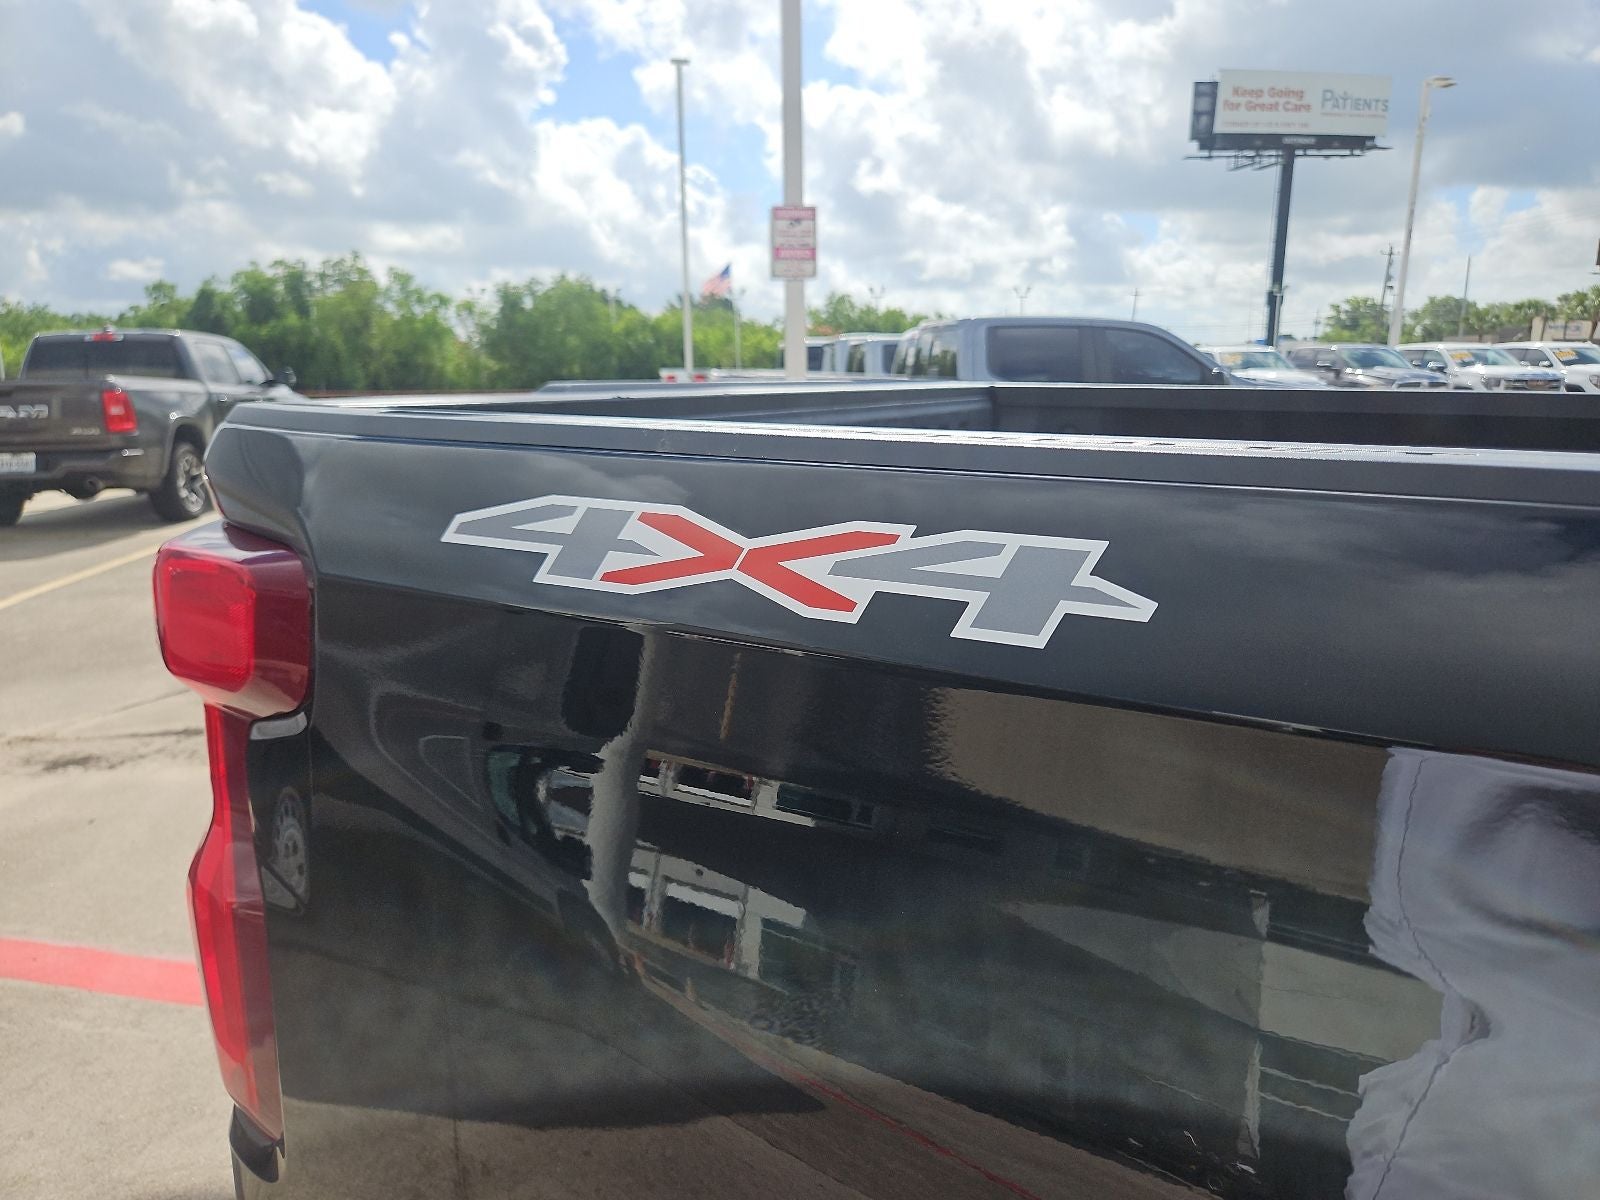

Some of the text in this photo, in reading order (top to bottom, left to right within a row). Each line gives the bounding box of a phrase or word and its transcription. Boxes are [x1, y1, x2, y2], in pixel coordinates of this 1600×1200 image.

[1231, 86, 1305, 101] Keep Going
[1222, 99, 1313, 113] for Great Care
